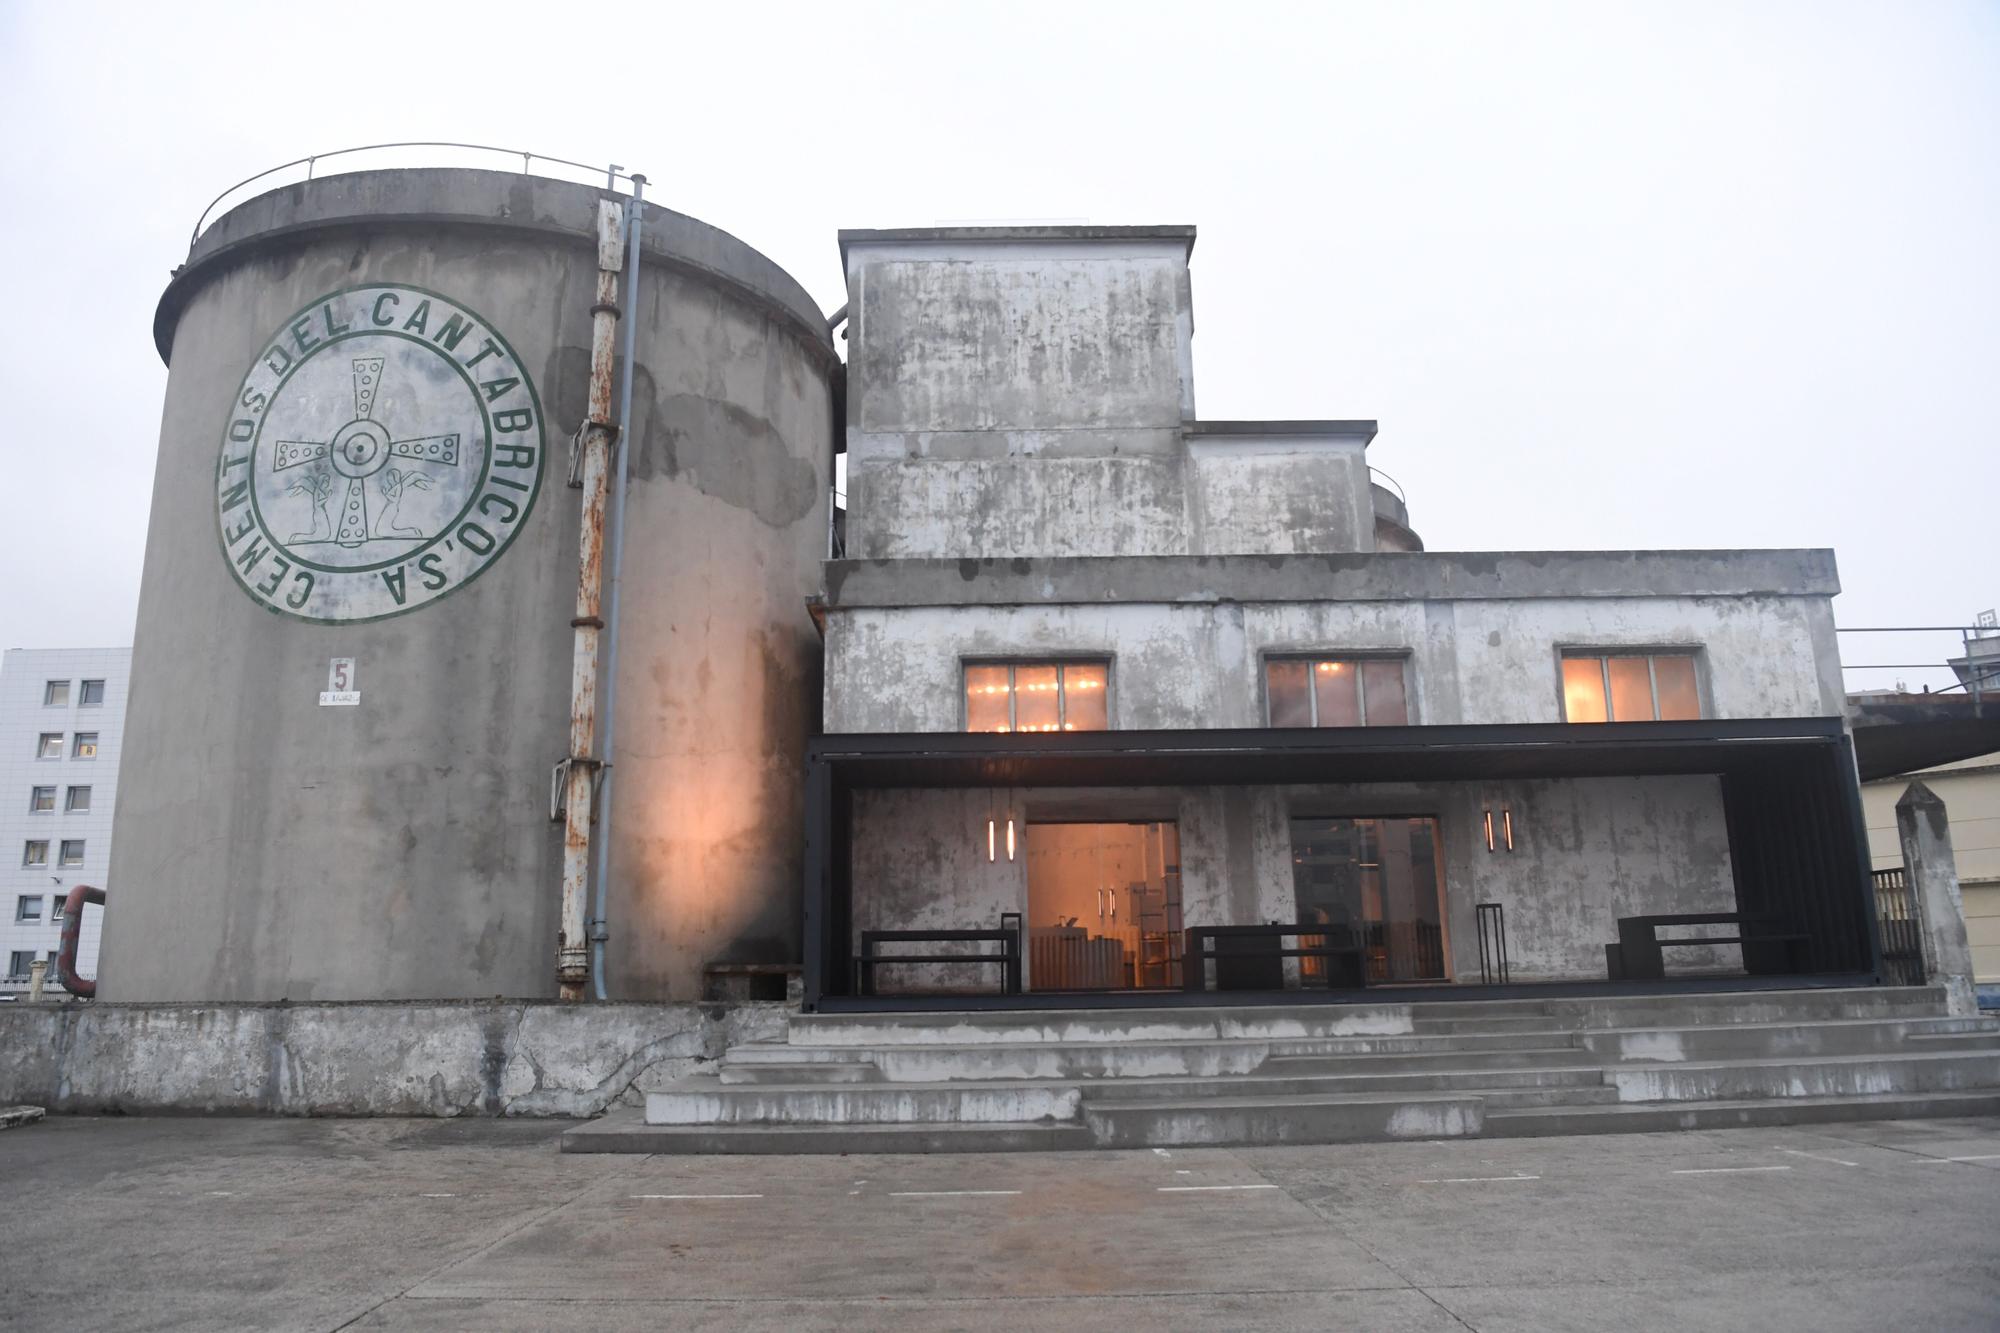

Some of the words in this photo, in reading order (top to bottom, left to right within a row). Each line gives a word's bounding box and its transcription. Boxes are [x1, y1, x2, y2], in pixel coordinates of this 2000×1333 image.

[262, 303, 351, 378] DEL
[221, 386, 316, 609] CEMENTOS
[334, 663, 348, 689] 5
